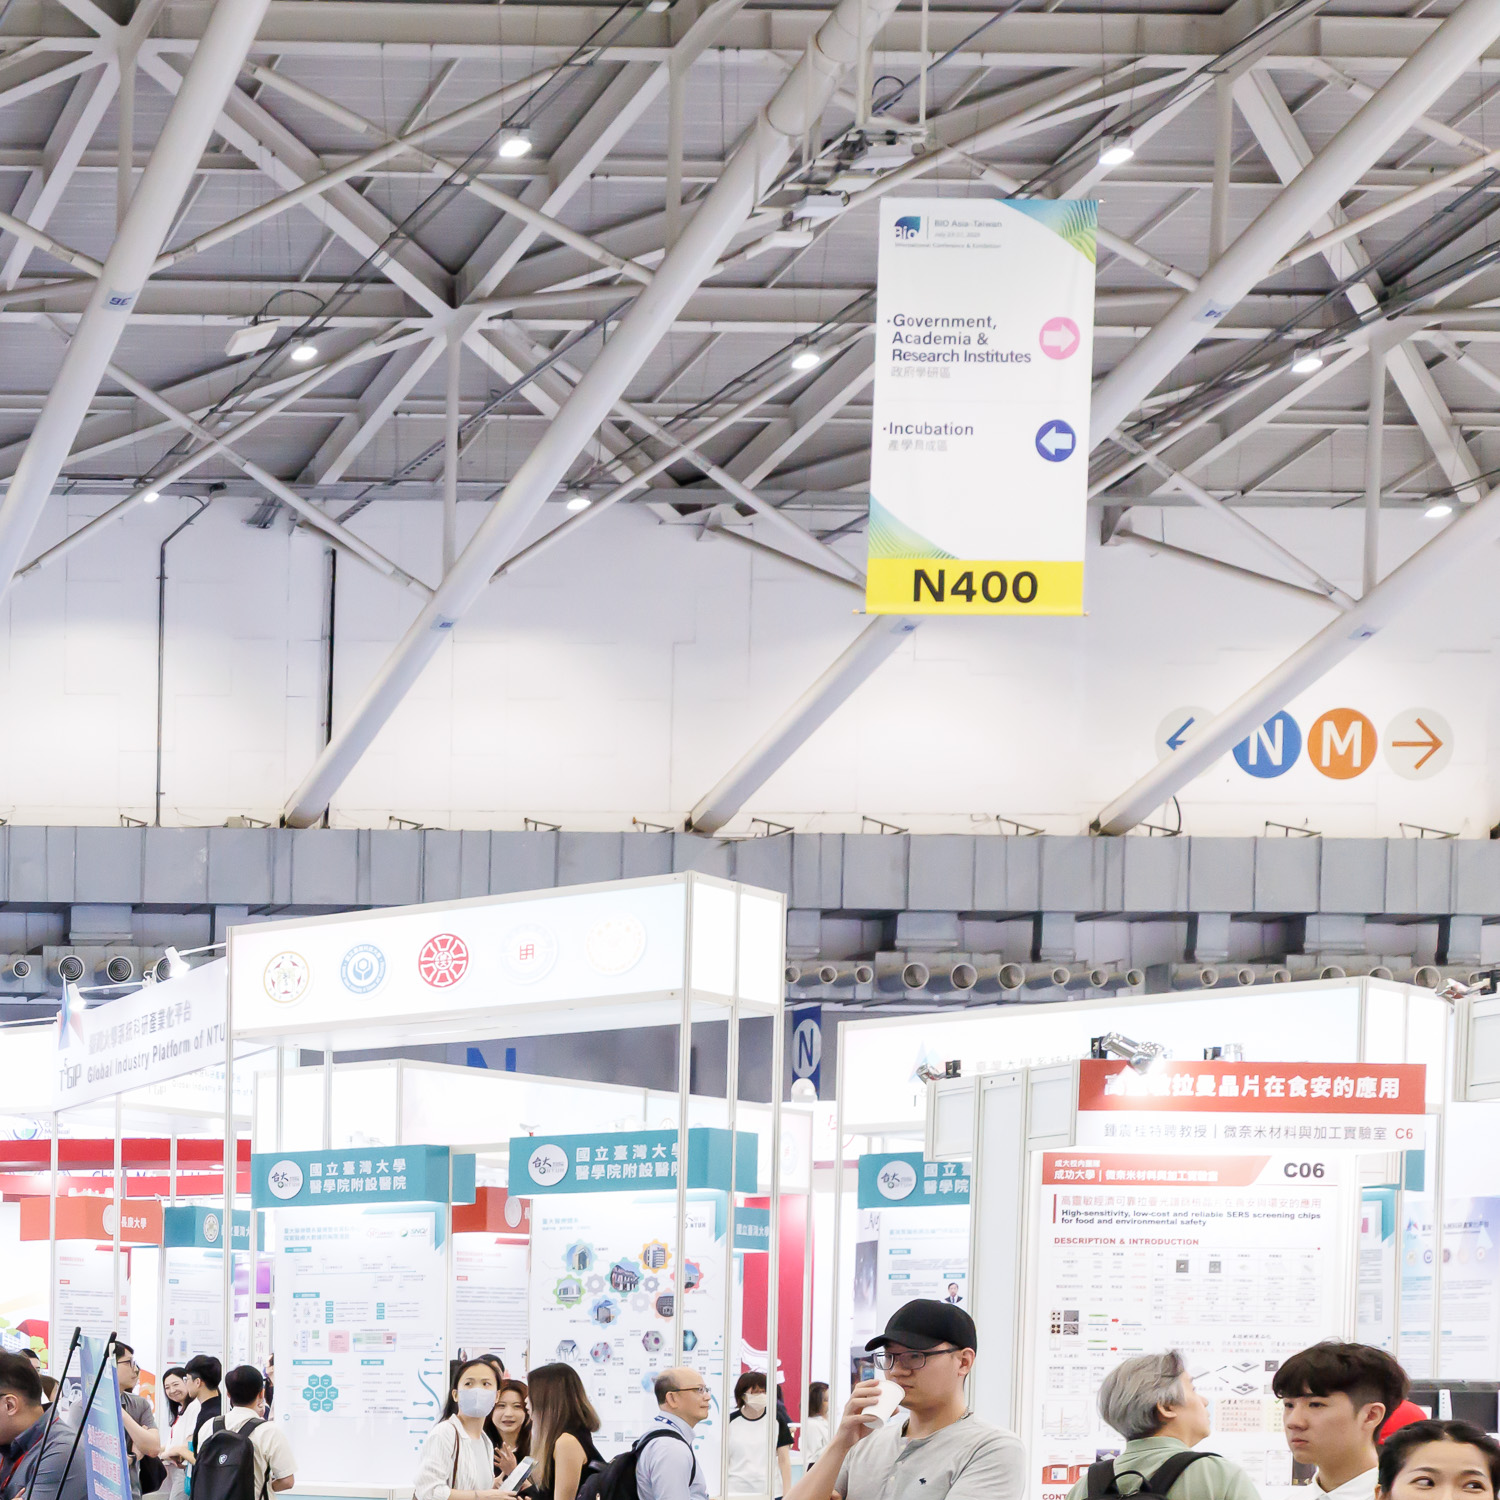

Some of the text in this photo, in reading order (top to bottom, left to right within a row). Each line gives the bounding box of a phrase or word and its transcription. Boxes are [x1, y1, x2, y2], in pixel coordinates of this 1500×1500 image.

[892, 314, 997, 330] Government,
[892, 332, 989, 346] Academia &
[892, 348, 1032, 363] Research Institutes
[889, 422, 974, 436] Incubation
[912, 568, 1040, 604] N400
[1247, 716, 1364, 768] N M
[87, 1058, 112, 1084] Global
[114, 1052, 150, 1072] Industry
[152, 1038, 190, 1063] Platform
[194, 1028, 202, 1050] of
[799, 1028, 814, 1069] N
[1396, 1128, 1414, 1140] C6
[309, 1158, 406, 1177] 國立臺灣大學
[1054, 1170, 1096, 1180] 成功大學
[1283, 1162, 1325, 1178] C06
[309, 1176, 406, 1194] 醫學院附設醫院
[1061, 1210, 1132, 1218] High-sensitivity,
[1172, 1210, 1188, 1218] and
[1191, 1210, 1224, 1218] reliable
[1252, 1212, 1295, 1220] screening
[1298, 1212, 1321, 1220] chips
[1180, 1218, 1208, 1227] safety
[1054, 1237, 1117, 1245] DESCRIPTION
[1128, 1238, 1200, 1246] INTRODUCTION
